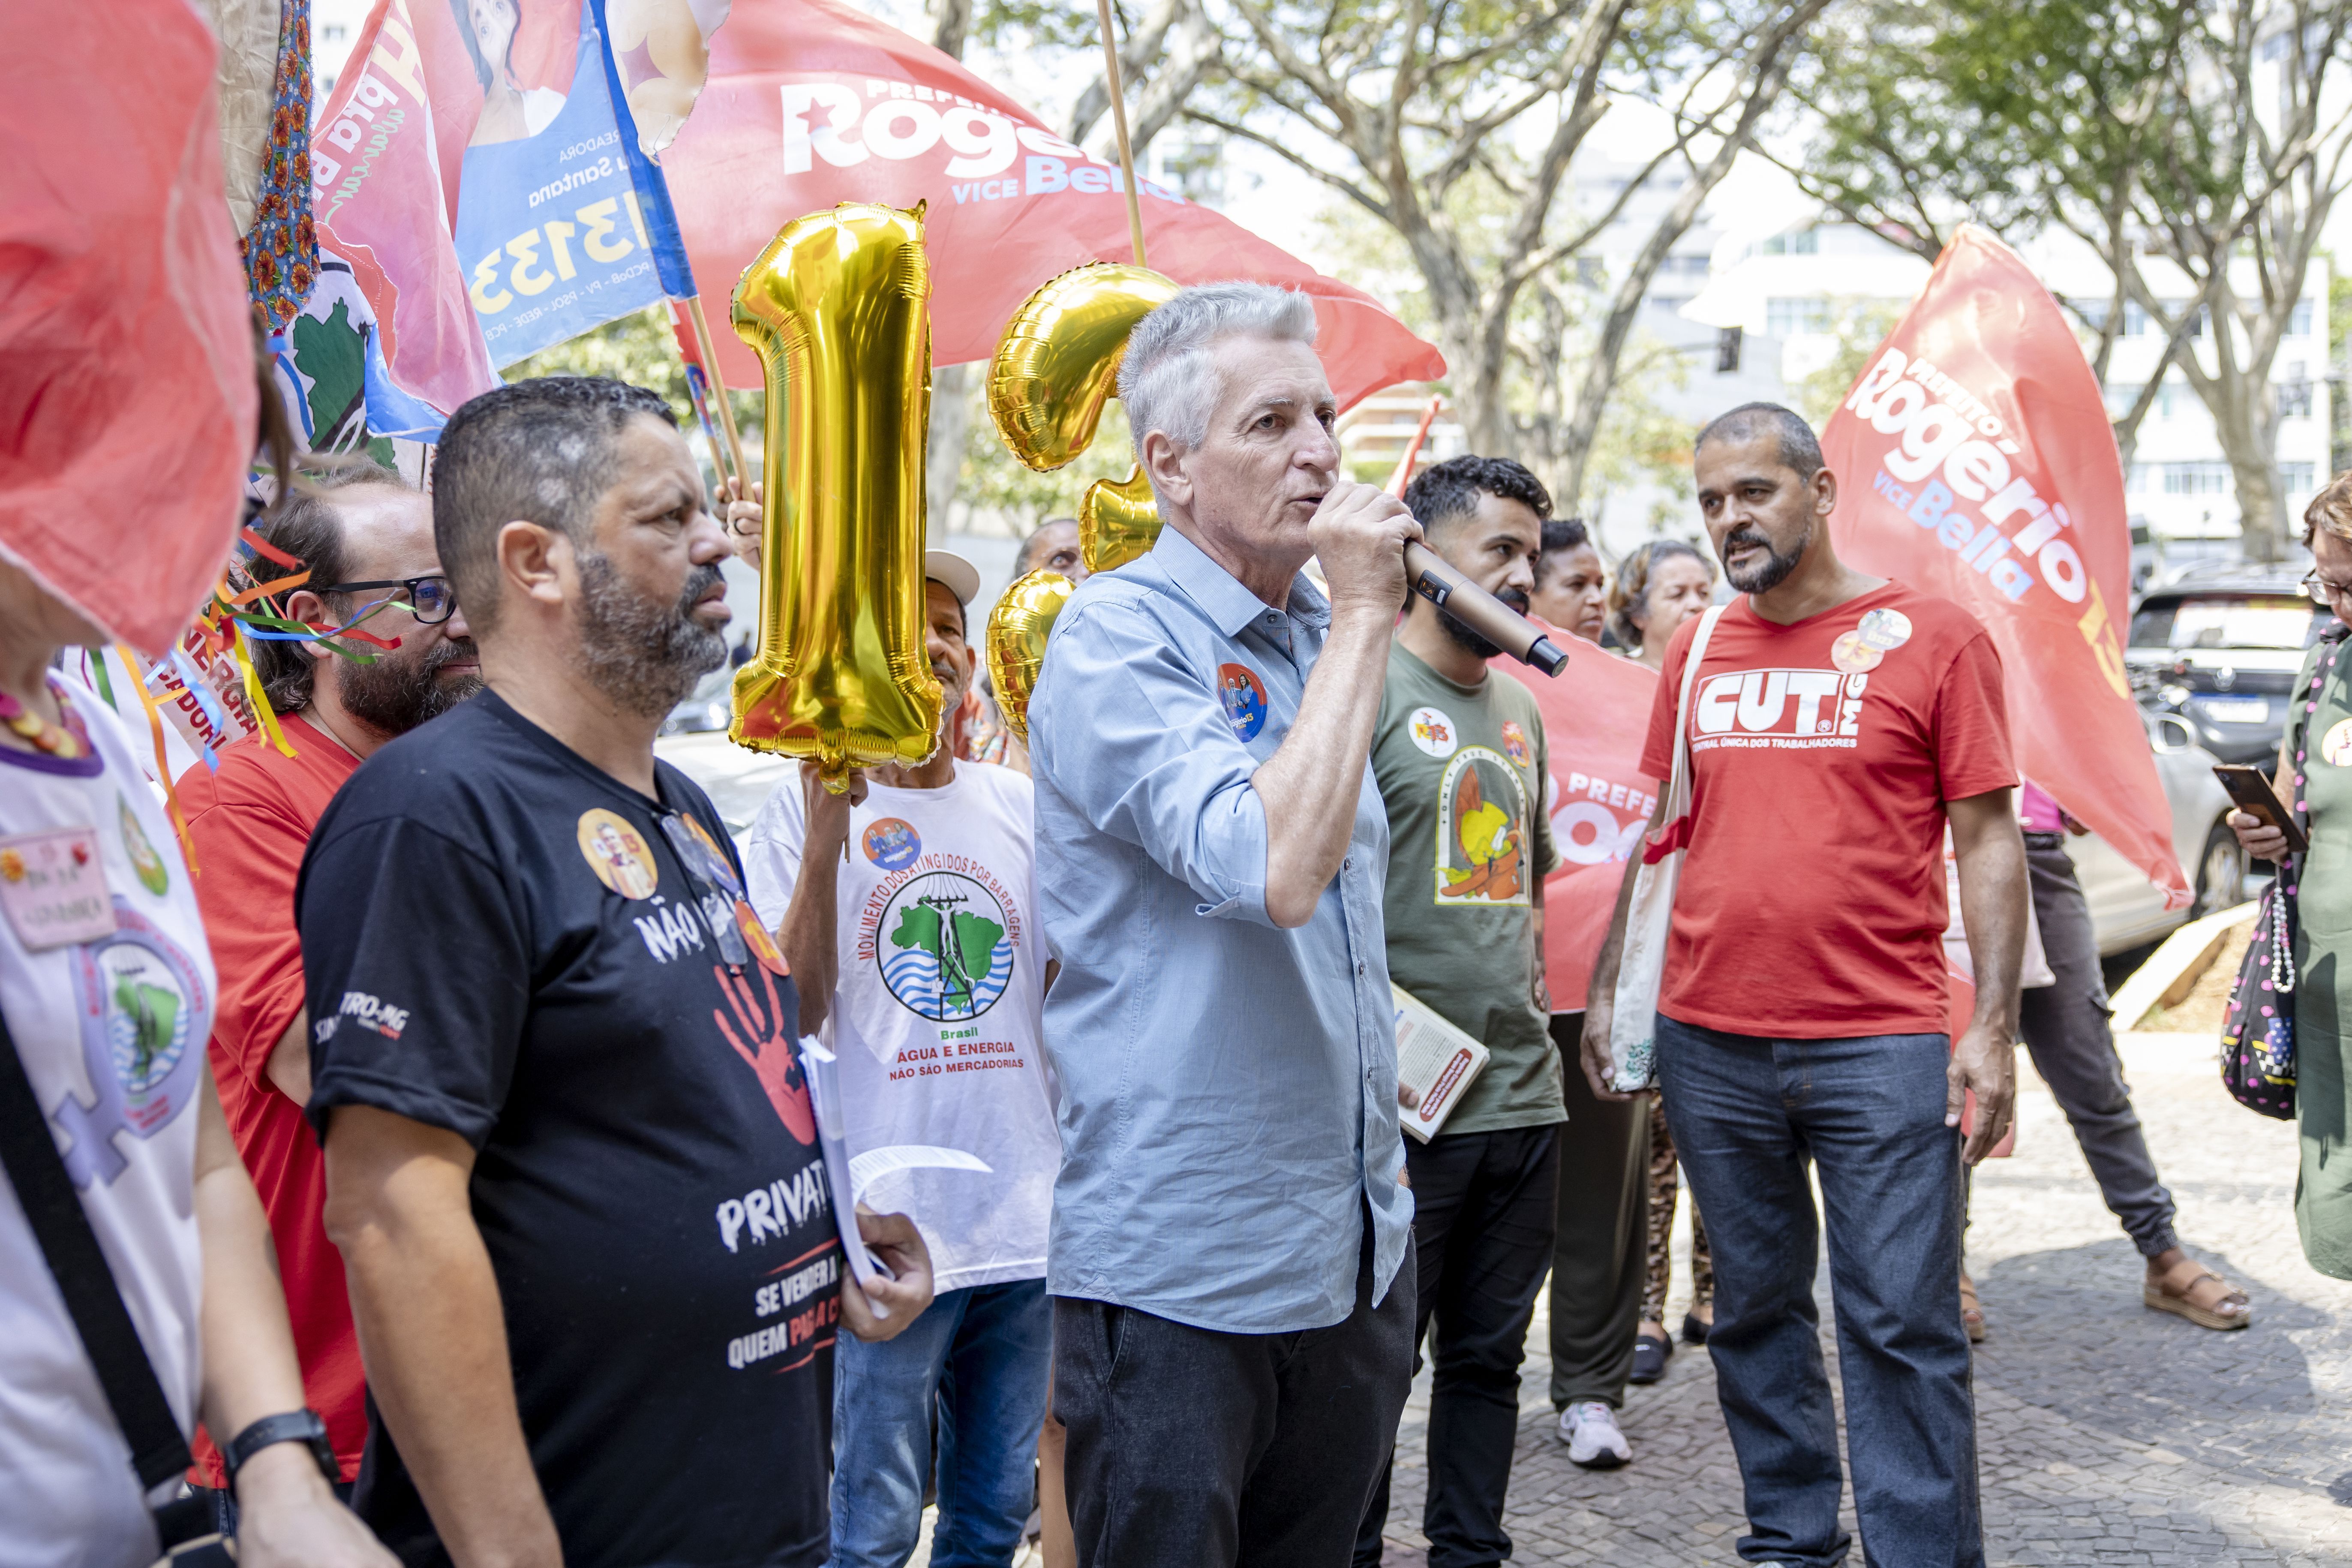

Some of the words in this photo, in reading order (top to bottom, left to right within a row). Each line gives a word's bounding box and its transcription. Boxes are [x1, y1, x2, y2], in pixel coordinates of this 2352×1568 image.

[951, 178, 1018, 205] VICE
[1905, 357, 2003, 436] PREFEITO
[1844, 346, 2087, 604] Rogério
[1872, 470, 1913, 511] VICE
[1907, 478, 2035, 601] Bella
[1245, 712, 1254, 722] 13
[1697, 671, 1841, 734] CUT
[1839, 673, 1868, 736] MG
[1720, 736, 1749, 748] ÚNICA
[1750, 738, 1770, 748] DOS
[1772, 737, 1857, 749] TRABALHADORES
[633, 895, 706, 964] NÃO
[858, 884, 891, 961] MOVIMENTO
[970, 861, 991, 883] POR
[988, 878, 1021, 947] BARRAGENS
[896, 1047, 938, 1063] ÁGUA
[943, 1045, 953, 1057] E
[958, 1042, 1015, 1056] ENERGIA
[940, 1027, 978, 1040] Brasil
[889, 1067, 915, 1081] NÃO
[919, 1063, 942, 1076] SÃO
[946, 1059, 1024, 1073] MERCADORIAS
[755, 1282, 781, 1318] SE
[727, 1322, 787, 1370] QUEM
